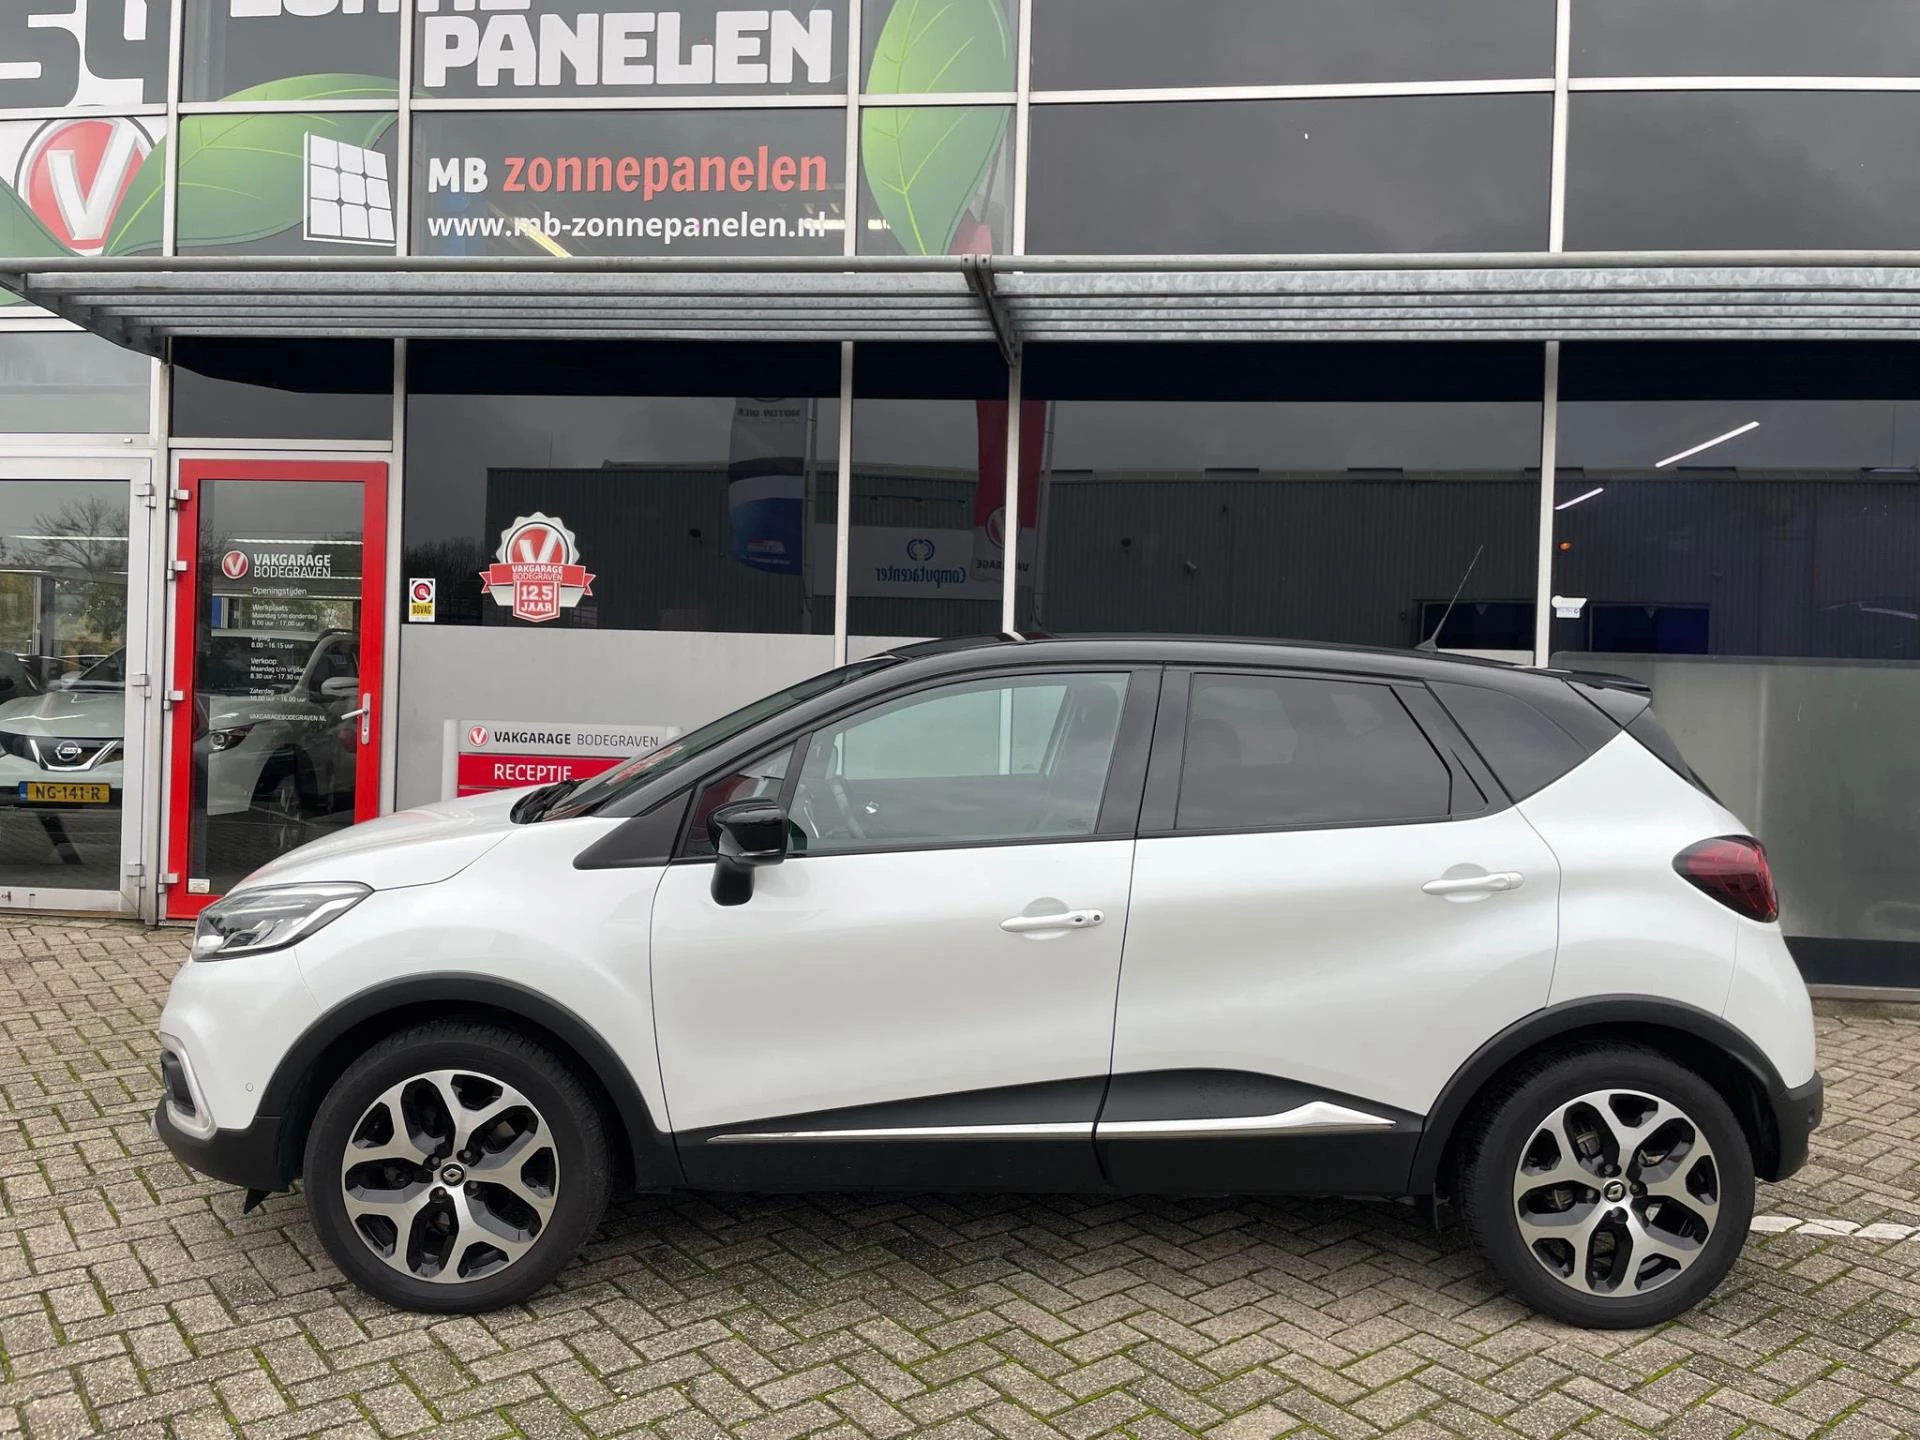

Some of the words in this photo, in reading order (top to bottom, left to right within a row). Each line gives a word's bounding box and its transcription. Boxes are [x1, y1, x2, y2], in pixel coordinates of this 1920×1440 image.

[424, 10, 832, 87] PANELEN
[428, 157, 488, 193] MB
[503, 145, 827, 202] zonnepanelen
[428, 211, 825, 244] www.mb-zonnepanelen.nl
[253, 553, 331, 566] VAKGARAGE
[254, 566, 331, 578] BODEGRAVEN
[512, 564, 564, 573] VAKGARAGE
[513, 572, 563, 581] BODEGRAVEN
[252, 586, 307, 597] Openingstijden
[521, 585, 553, 601] 12.5
[412, 605, 432, 614] BOVAG
[521, 602, 552, 612] JAAR
[494, 731, 571, 745] VAKGARAGE
[577, 733, 659, 748] BODEGRAVEN
[494, 763, 573, 781] RECEPTIE
[36, 786, 100, 800] NG-141-R
